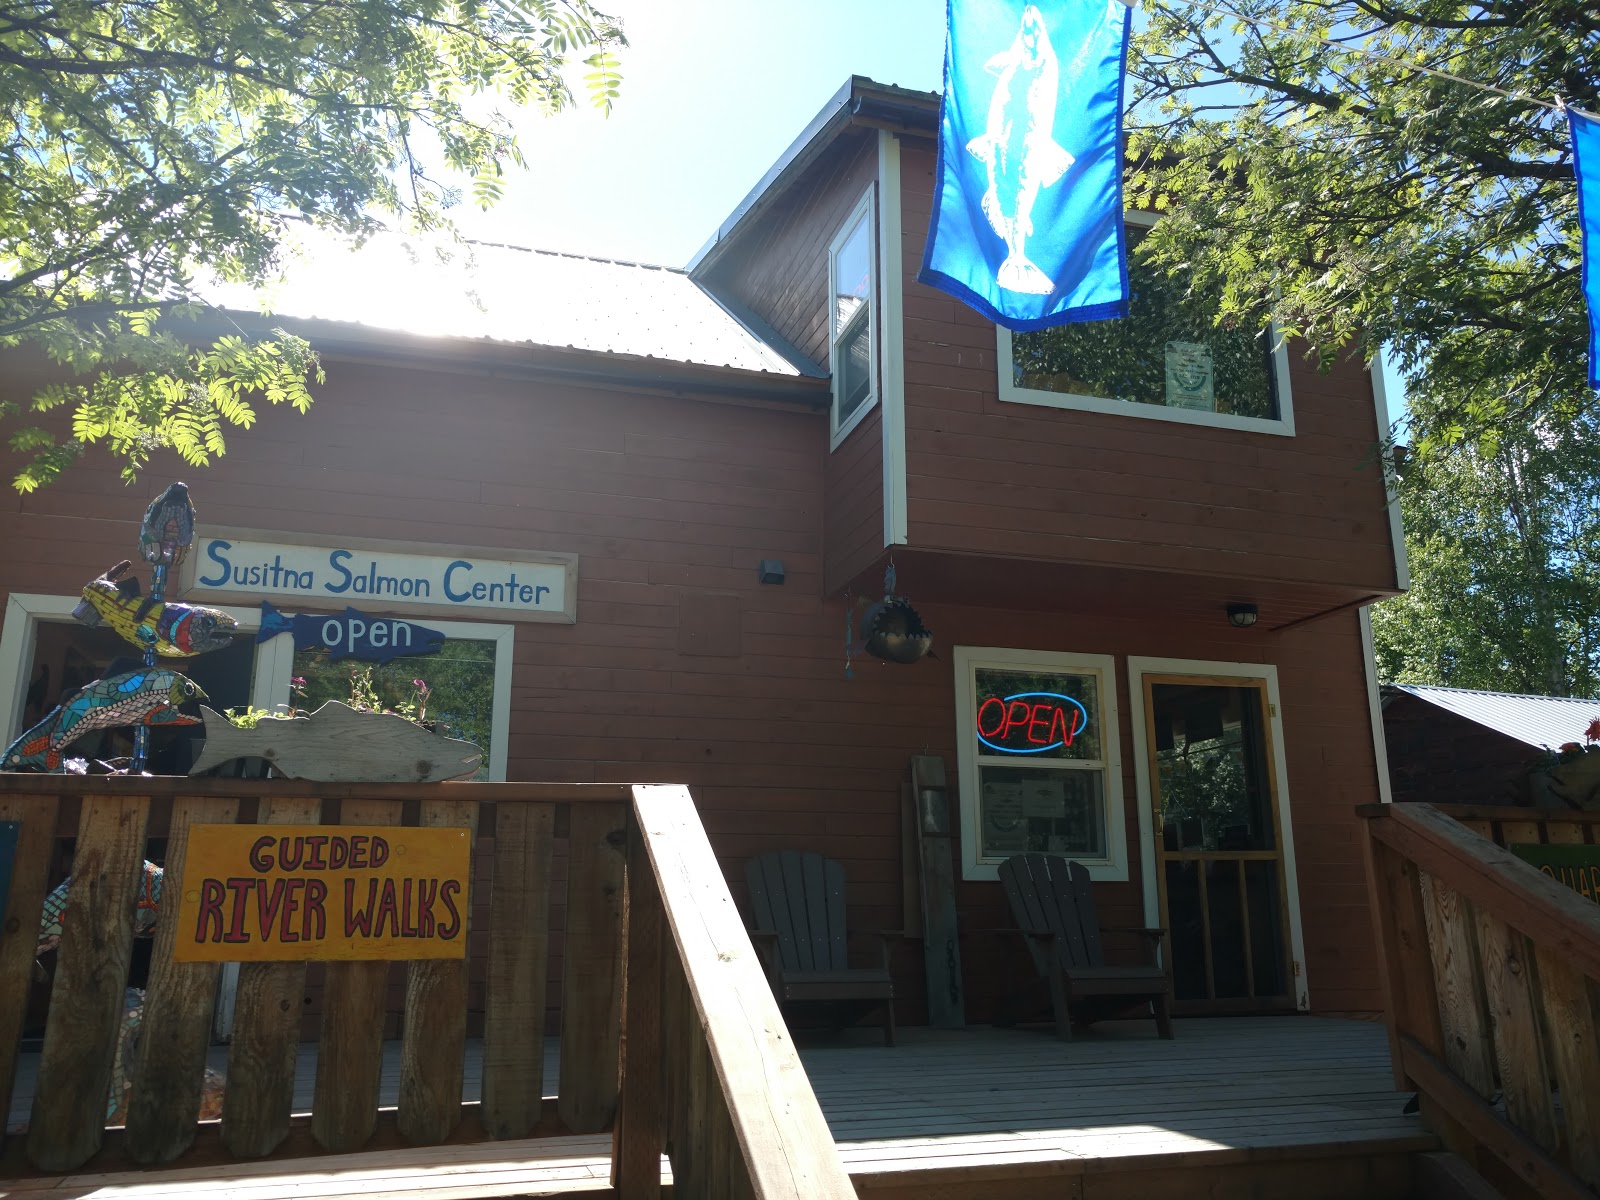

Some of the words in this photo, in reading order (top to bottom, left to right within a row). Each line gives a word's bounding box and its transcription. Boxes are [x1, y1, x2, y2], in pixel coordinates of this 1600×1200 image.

[199, 539, 314, 590] Susitna
[324, 550, 430, 597] Salmon
[443, 560, 550, 605] Center
[321, 619, 412, 653] open
[977, 697, 1079, 747] OPEN
[249, 835, 390, 873] GUIDED
[194, 877, 328, 943] RIVER
[344, 877, 461, 941] WALKS
